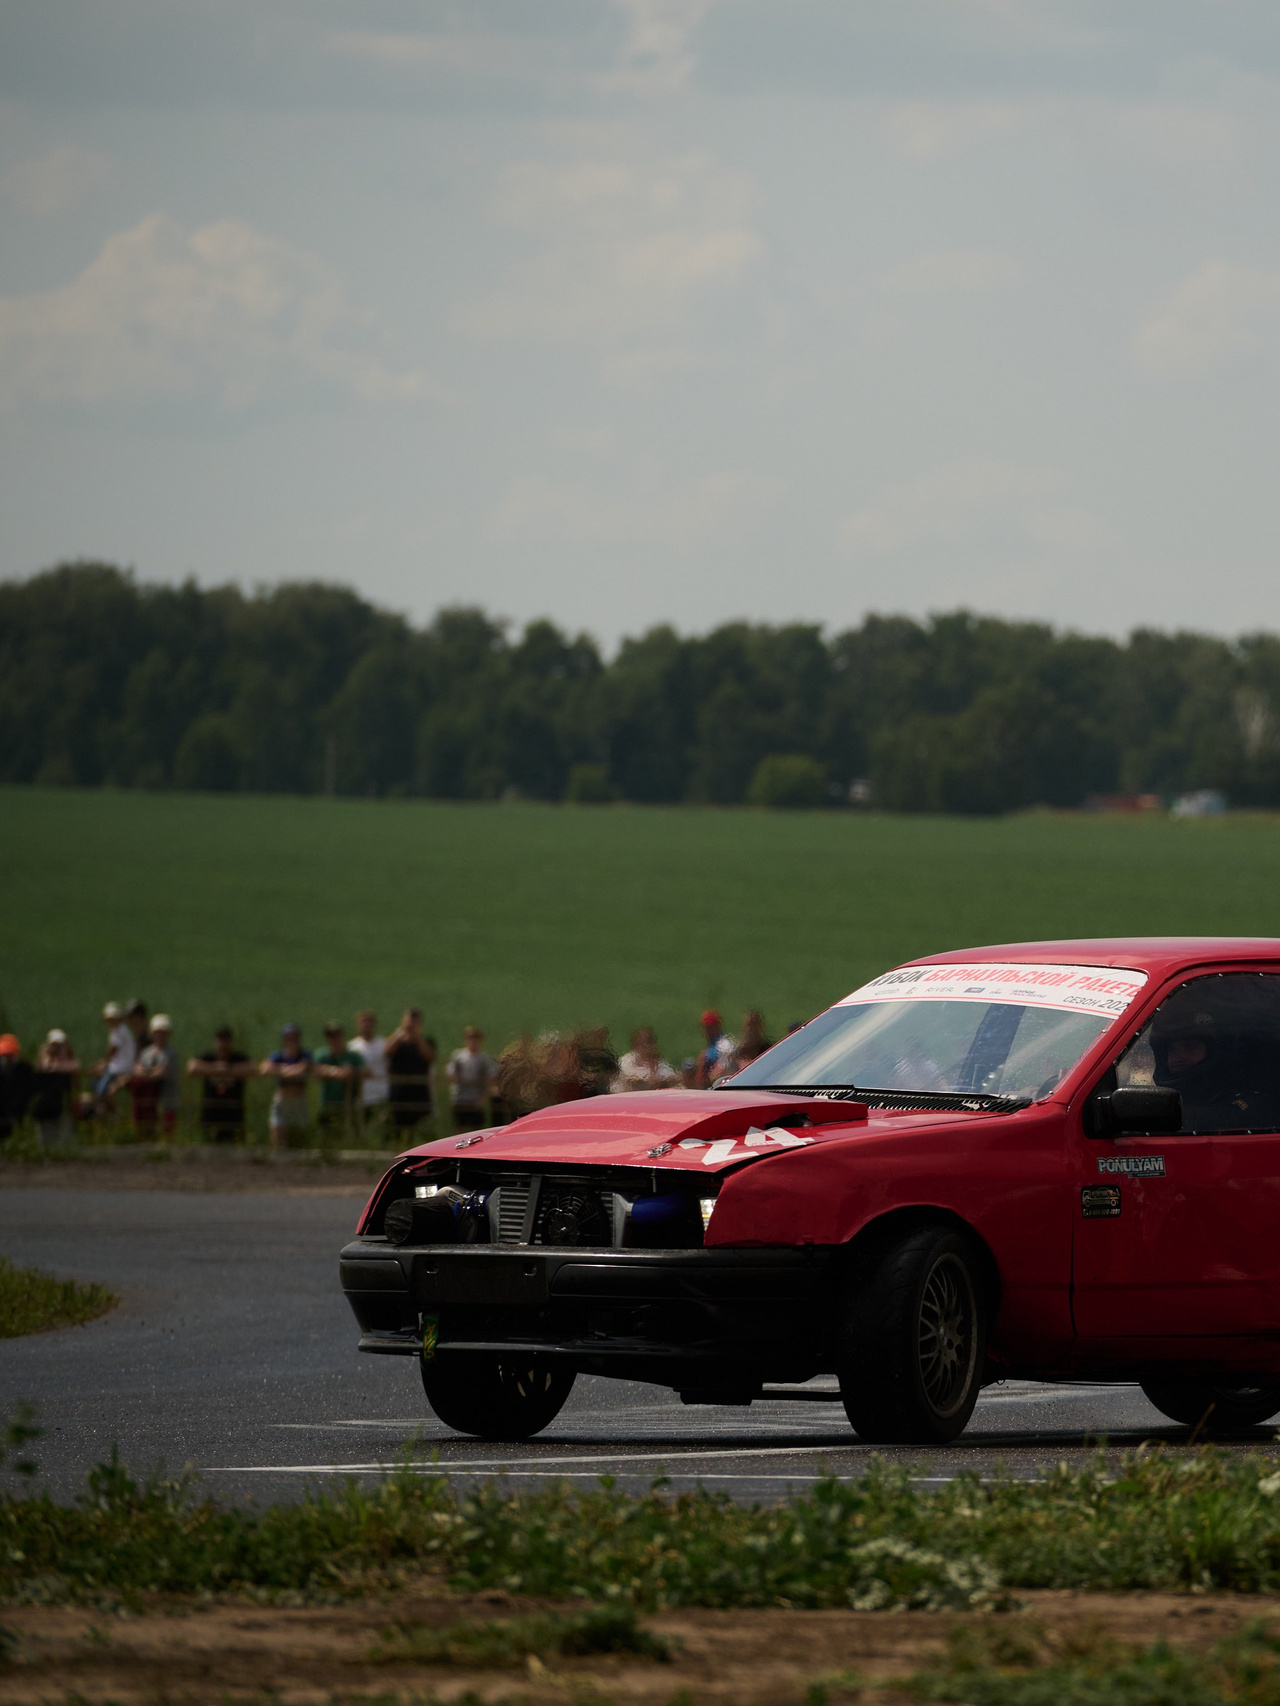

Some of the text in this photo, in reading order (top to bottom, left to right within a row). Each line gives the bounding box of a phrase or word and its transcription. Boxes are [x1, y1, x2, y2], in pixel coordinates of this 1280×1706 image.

[867, 970, 933, 987] КУБОК
[923, 969, 1074, 988] БАРНАУЛЬСКОЙ
[1063, 996, 1131, 1011] СЕЗОН 202
[678, 1126, 815, 1165] 24
